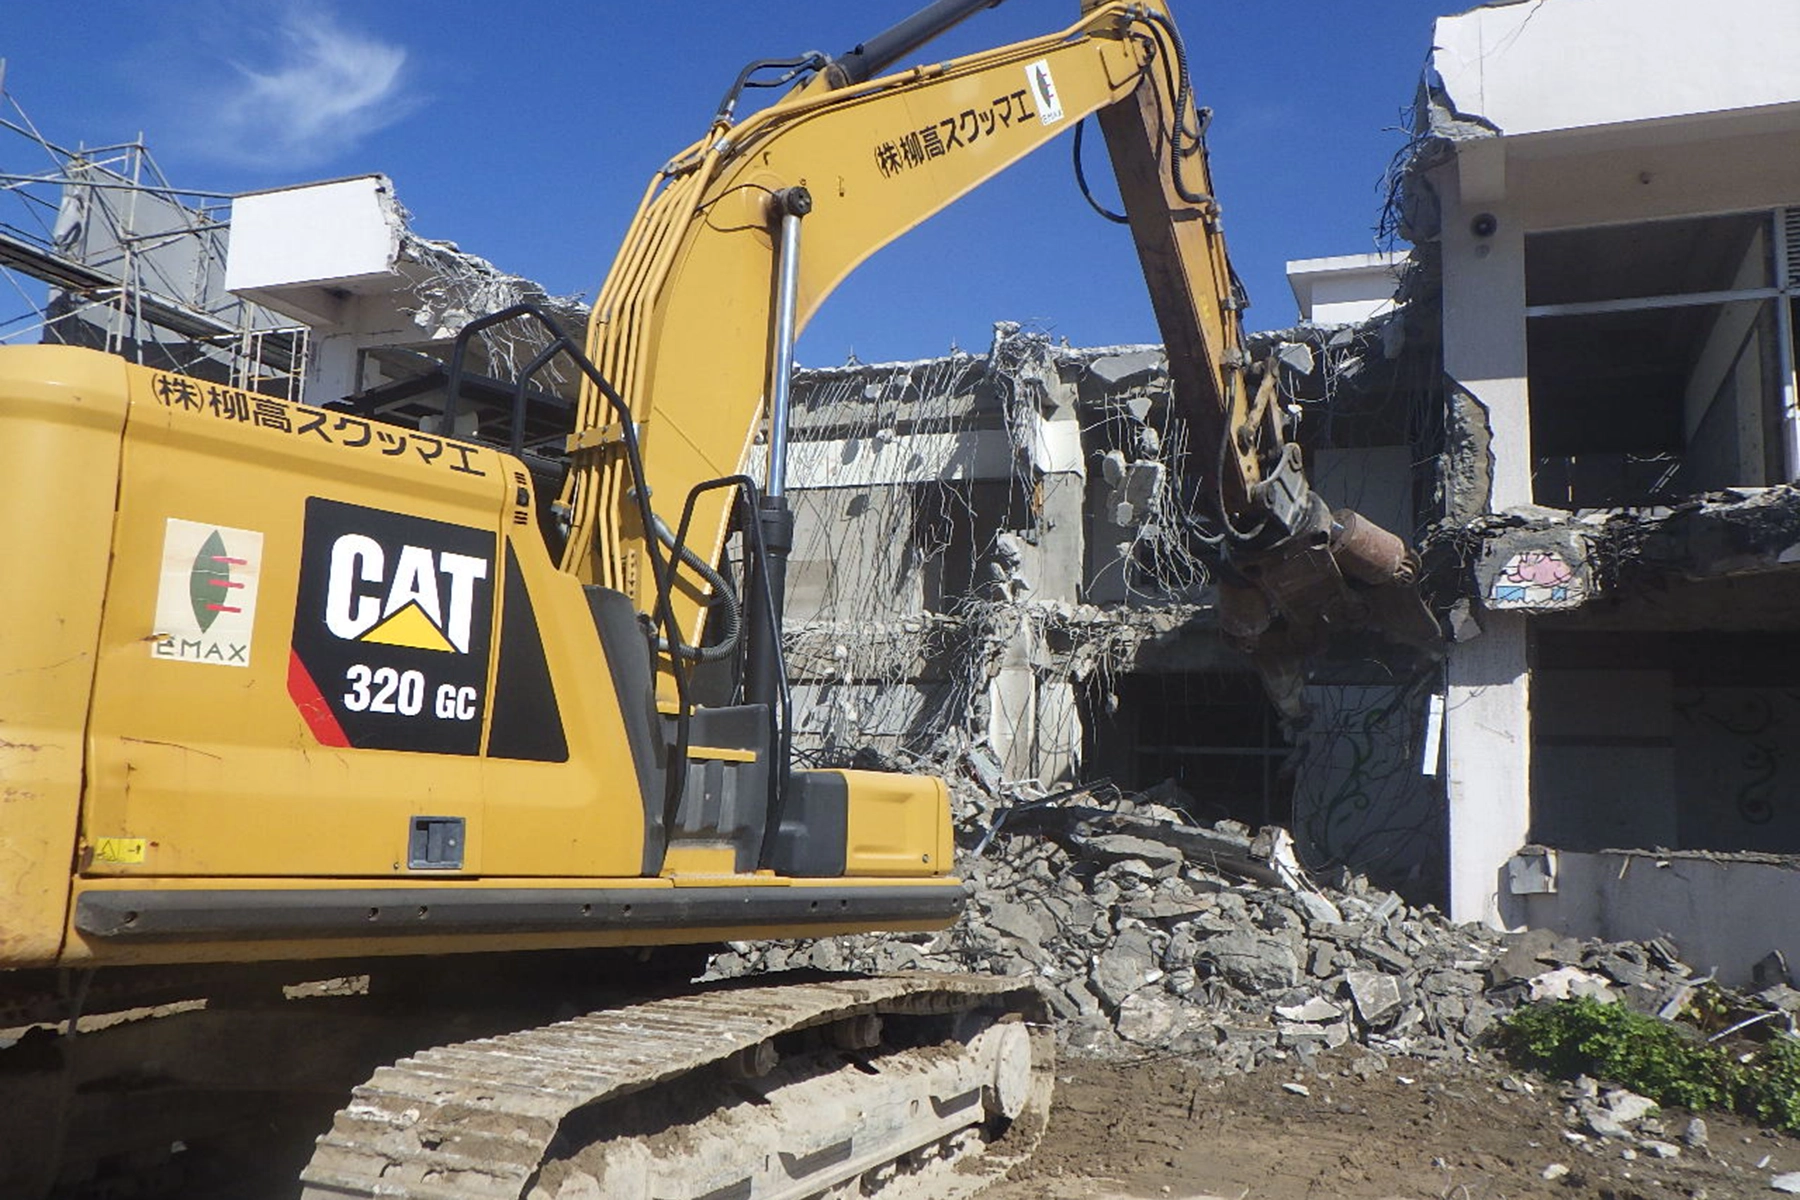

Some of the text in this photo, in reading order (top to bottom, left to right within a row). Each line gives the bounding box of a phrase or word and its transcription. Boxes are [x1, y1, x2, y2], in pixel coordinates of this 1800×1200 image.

[325, 533, 487, 654] CAT
[344, 663, 476, 721] 320 GC
